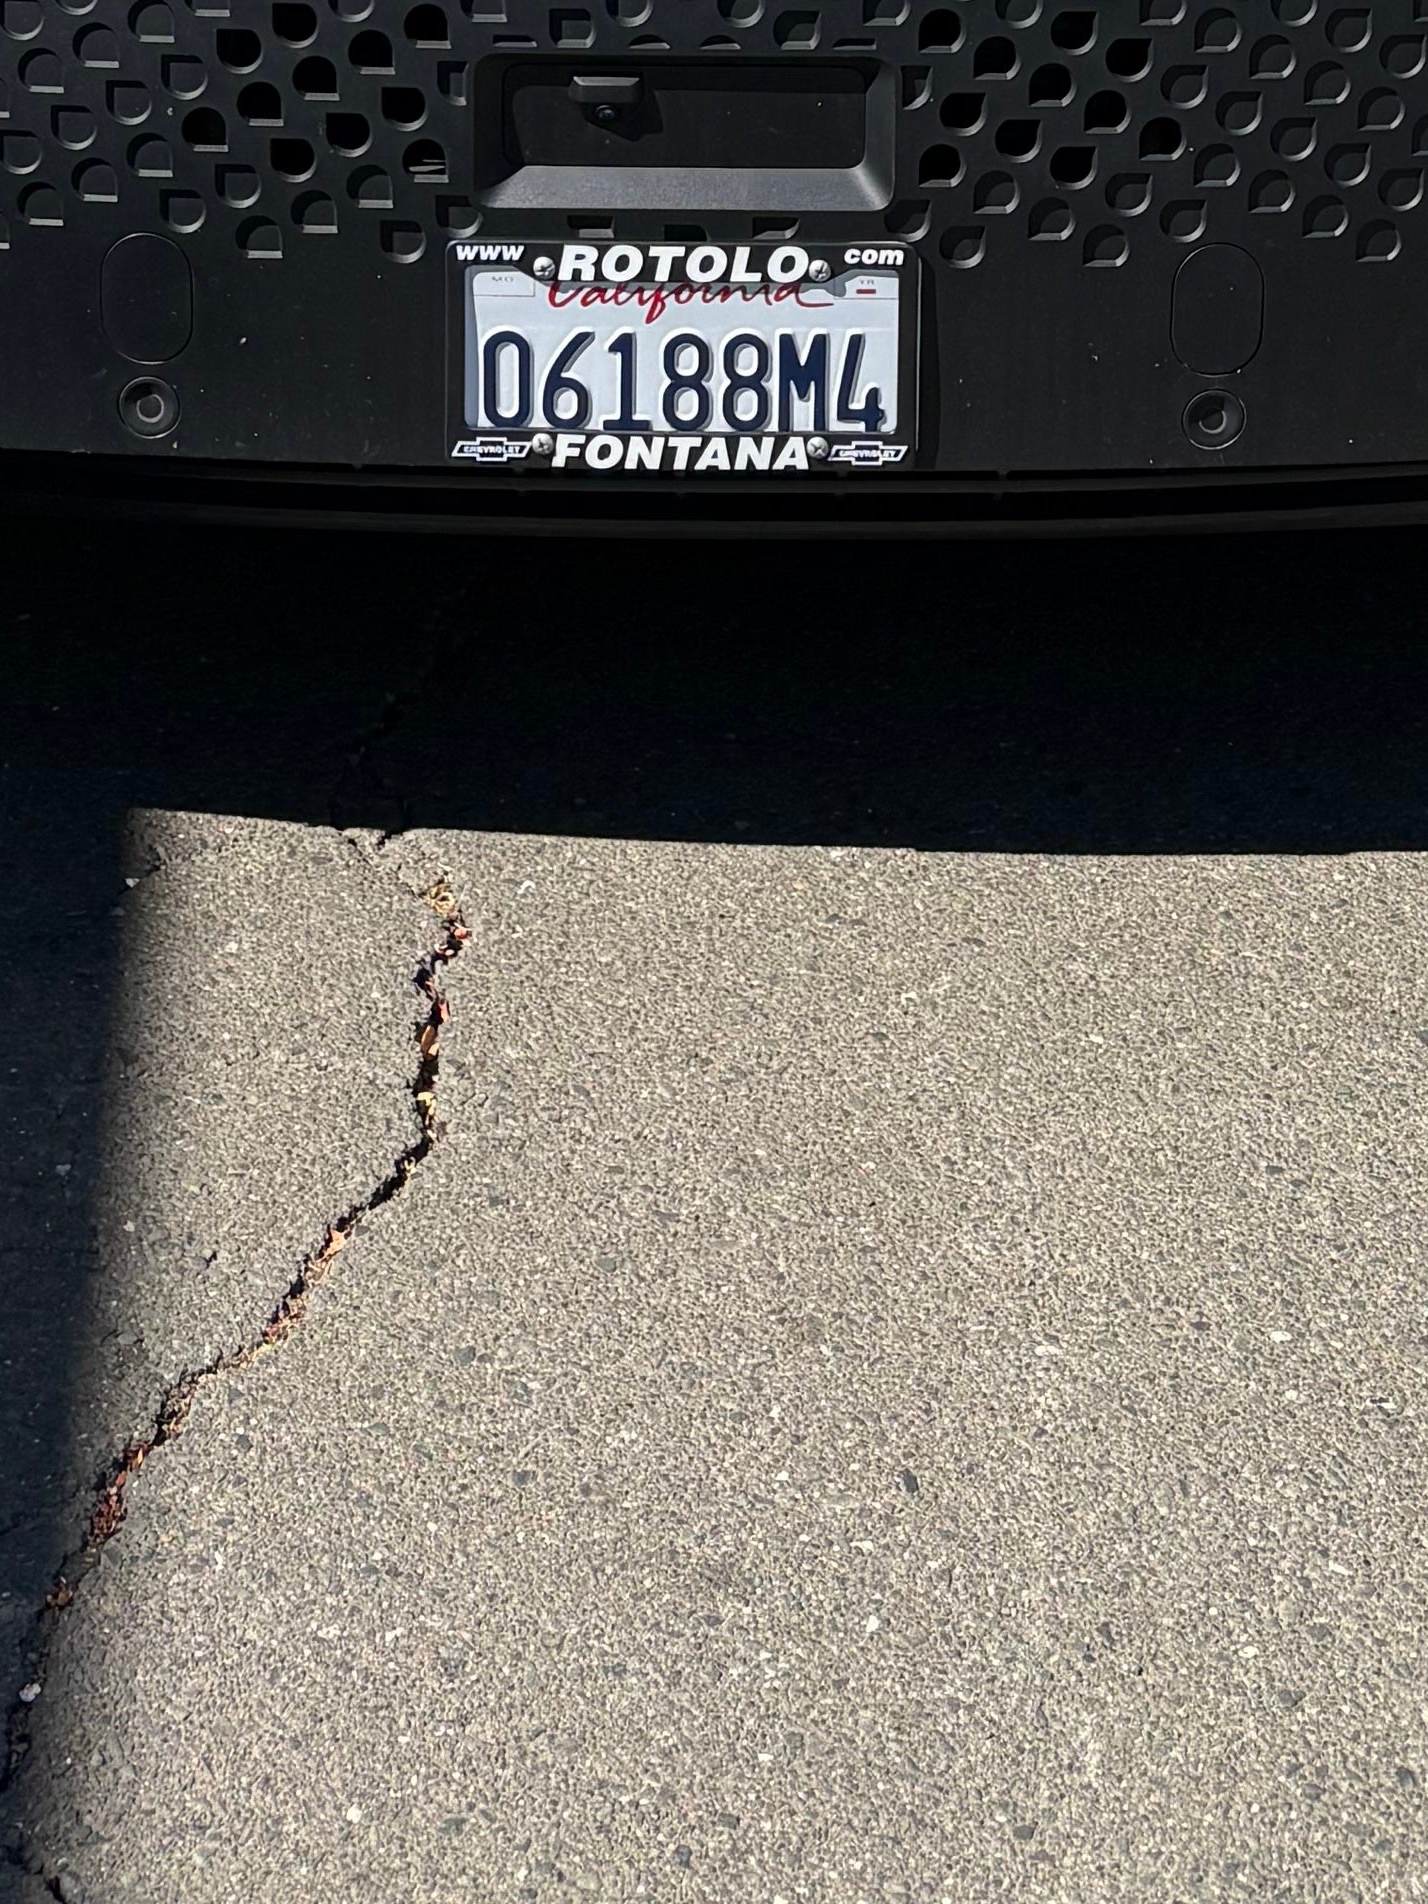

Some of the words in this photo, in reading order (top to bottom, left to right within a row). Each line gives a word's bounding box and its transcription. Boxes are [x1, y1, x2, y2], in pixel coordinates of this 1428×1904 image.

[455, 244, 525, 263] www
[557, 244, 809, 284] ROTOLO
[843, 246, 905, 267] com
[482, 330, 886, 432] 06188M4
[551, 434, 811, 471] FONTANA
